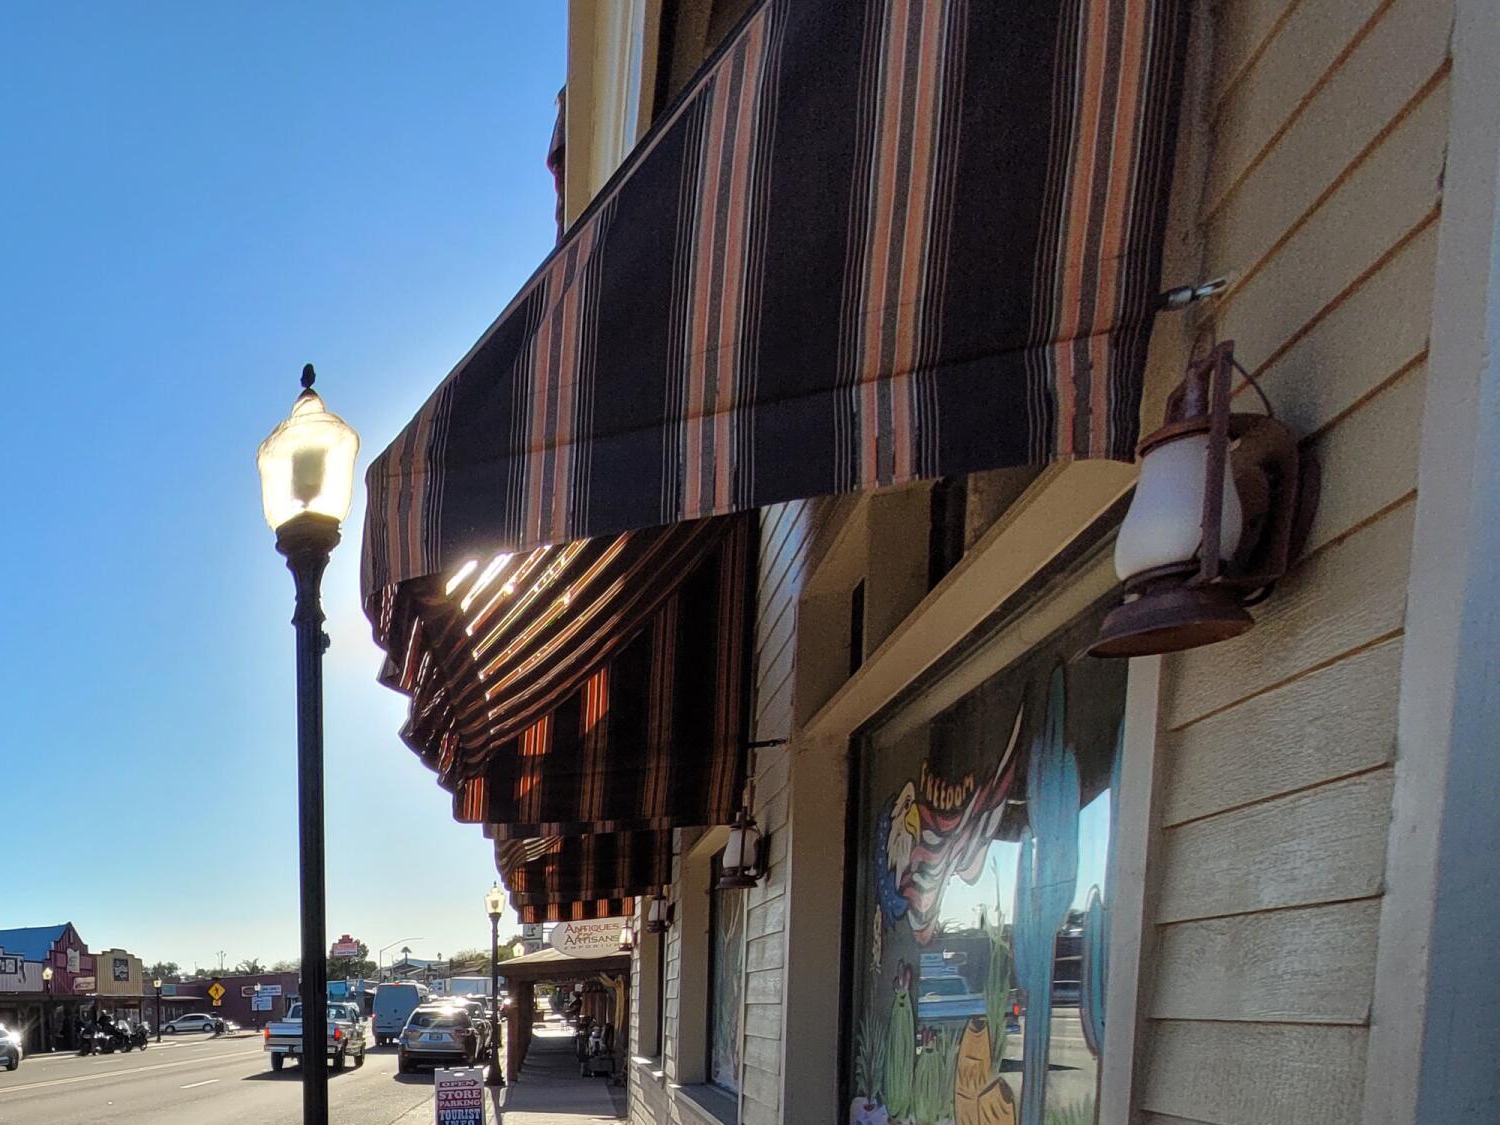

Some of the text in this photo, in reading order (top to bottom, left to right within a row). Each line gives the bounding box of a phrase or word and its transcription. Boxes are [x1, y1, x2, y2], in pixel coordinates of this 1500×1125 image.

[920, 760, 974, 810] FREEDOM
[439, 1090, 480, 1100] STORE
[439, 1109, 480, 1120] TOURIST
